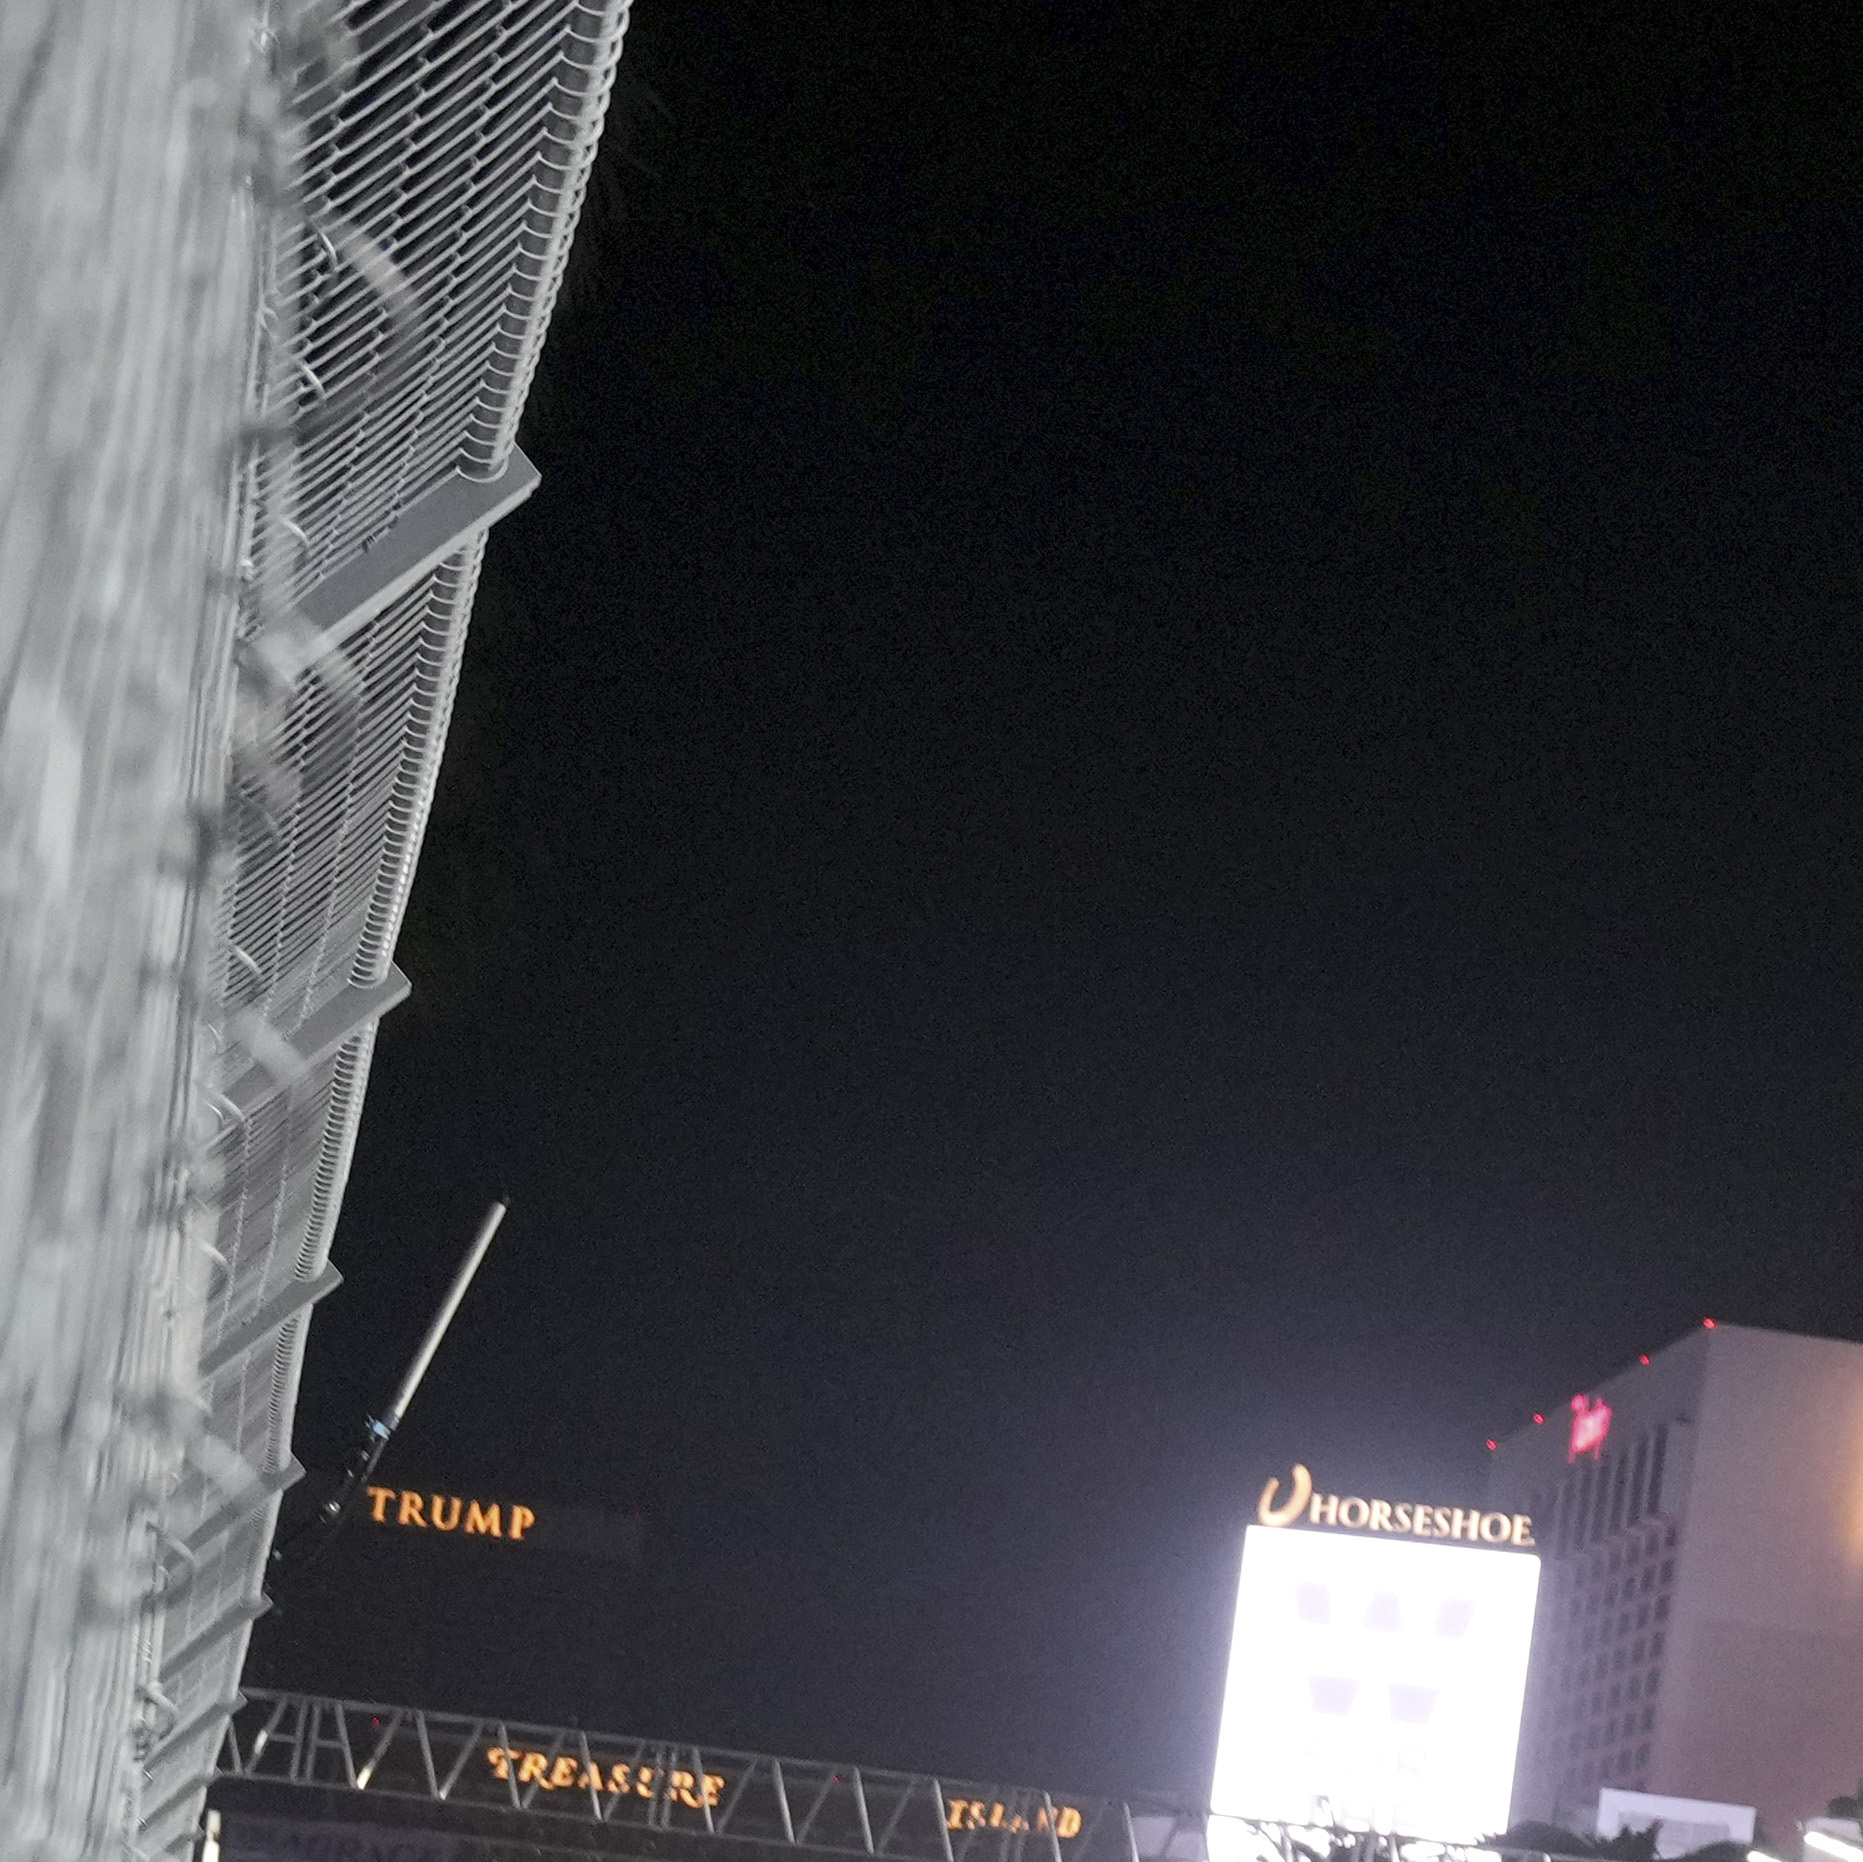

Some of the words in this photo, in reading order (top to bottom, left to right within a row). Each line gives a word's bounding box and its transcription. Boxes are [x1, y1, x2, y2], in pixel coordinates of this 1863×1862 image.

[367, 1486, 536, 1541] TRUMP
[1309, 1492, 1537, 1547] HORSESHOE
[487, 1747, 725, 1809] TREASURE
[947, 1799, 1083, 1839] ISLAND
